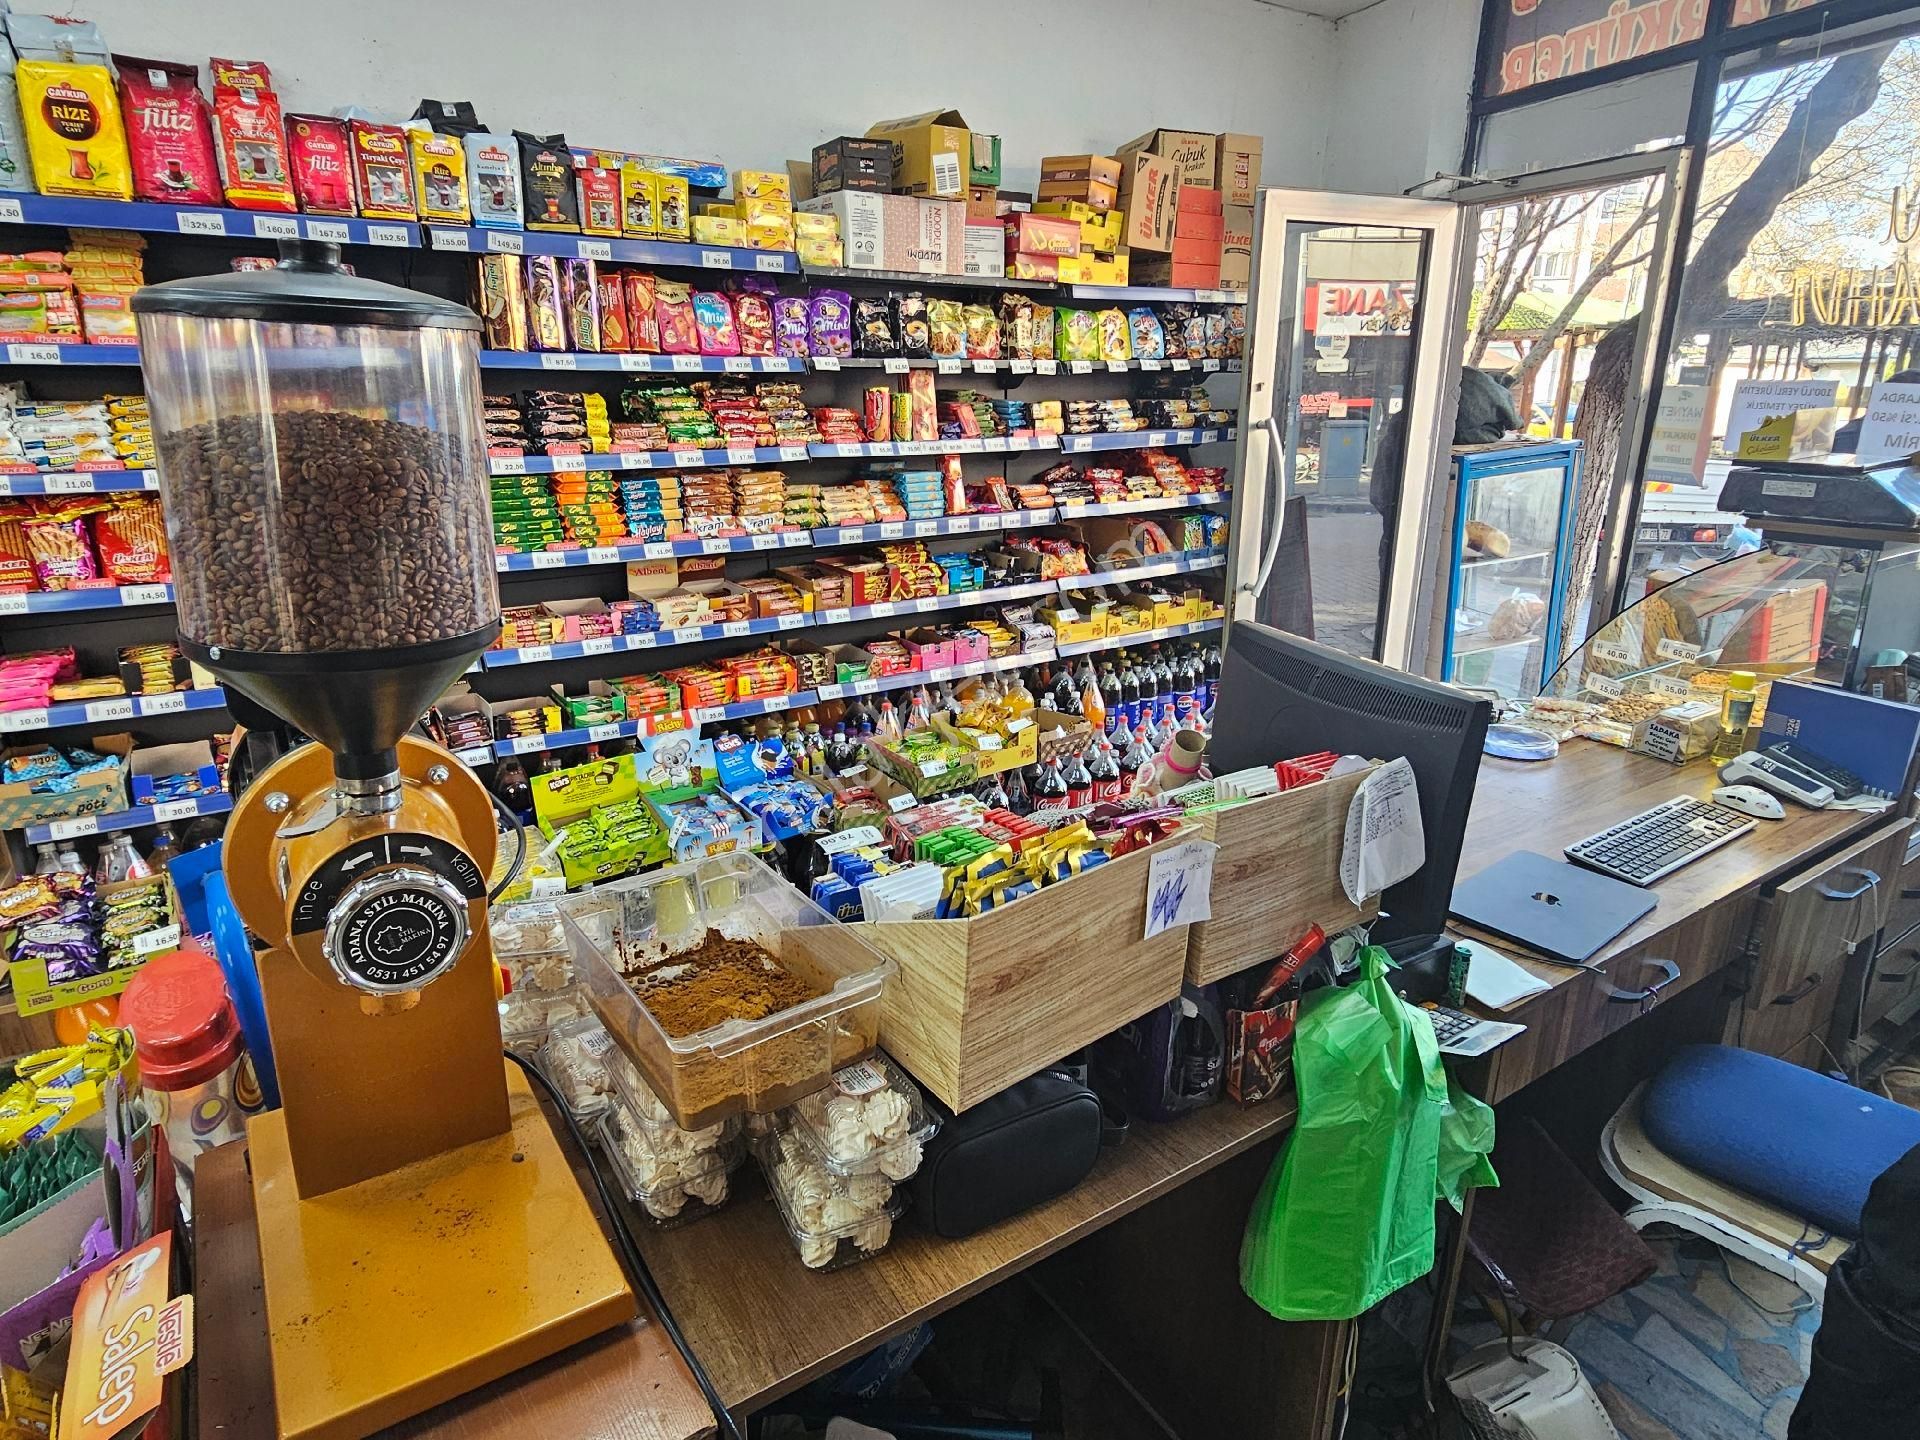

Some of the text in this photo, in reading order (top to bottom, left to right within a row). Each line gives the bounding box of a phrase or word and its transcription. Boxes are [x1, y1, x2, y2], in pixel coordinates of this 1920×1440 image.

[52, 105, 91, 121] RİZE
[143, 107, 193, 131] filiz
[309, 154, 340, 172] filiz
[361, 153, 387, 164] Tiryaki
[1138, 168, 1159, 240] ÜLKER
[190, 222, 222, 232] 329.50
[266, 225, 297, 236] 160.00
[318, 229, 348, 239] 167.50
[379, 233, 407, 243] 152.50
[441, 239, 467, 247] 155.00
[497, 240, 521, 251] 149.50
[591, 249, 610, 257] 65.00
[30, 352, 59, 361] 16.00
[1750, 434, 1781, 442] ÜLKER
[65, 480, 92, 490] 11.00
[113, 553, 154, 564] ÜLKER
[141, 591, 166, 600] 14.50
[1607, 649, 1628, 660] 40.00
[1673, 648, 1696, 661] 65.00
[1600, 684, 1621, 697] 15.00
[1665, 684, 1688, 696] 35.00
[160, 700, 184, 709] 15.00
[106, 706, 131, 715] 10.00
[20, 716, 46, 726] 10.00
[656, 718, 685, 733] Richy
[1649, 723, 1680, 740] SADAKA
[36, 809, 70, 821] Dankek
[172, 805, 196, 816] 30.00
[75, 823, 96, 833] 9.00
[820, 833, 854, 846] 75.00
[295, 879, 323, 921] ince
[349, 894, 450, 965] ADANA STİL MAKİNA
[155, 934, 178, 947] 16.50
[366, 935, 450, 981] 0531 451 54 97
[49, 968, 76, 981] Gong
[77, 977, 114, 995] Gong
[83, 1303, 156, 1426] Salep
